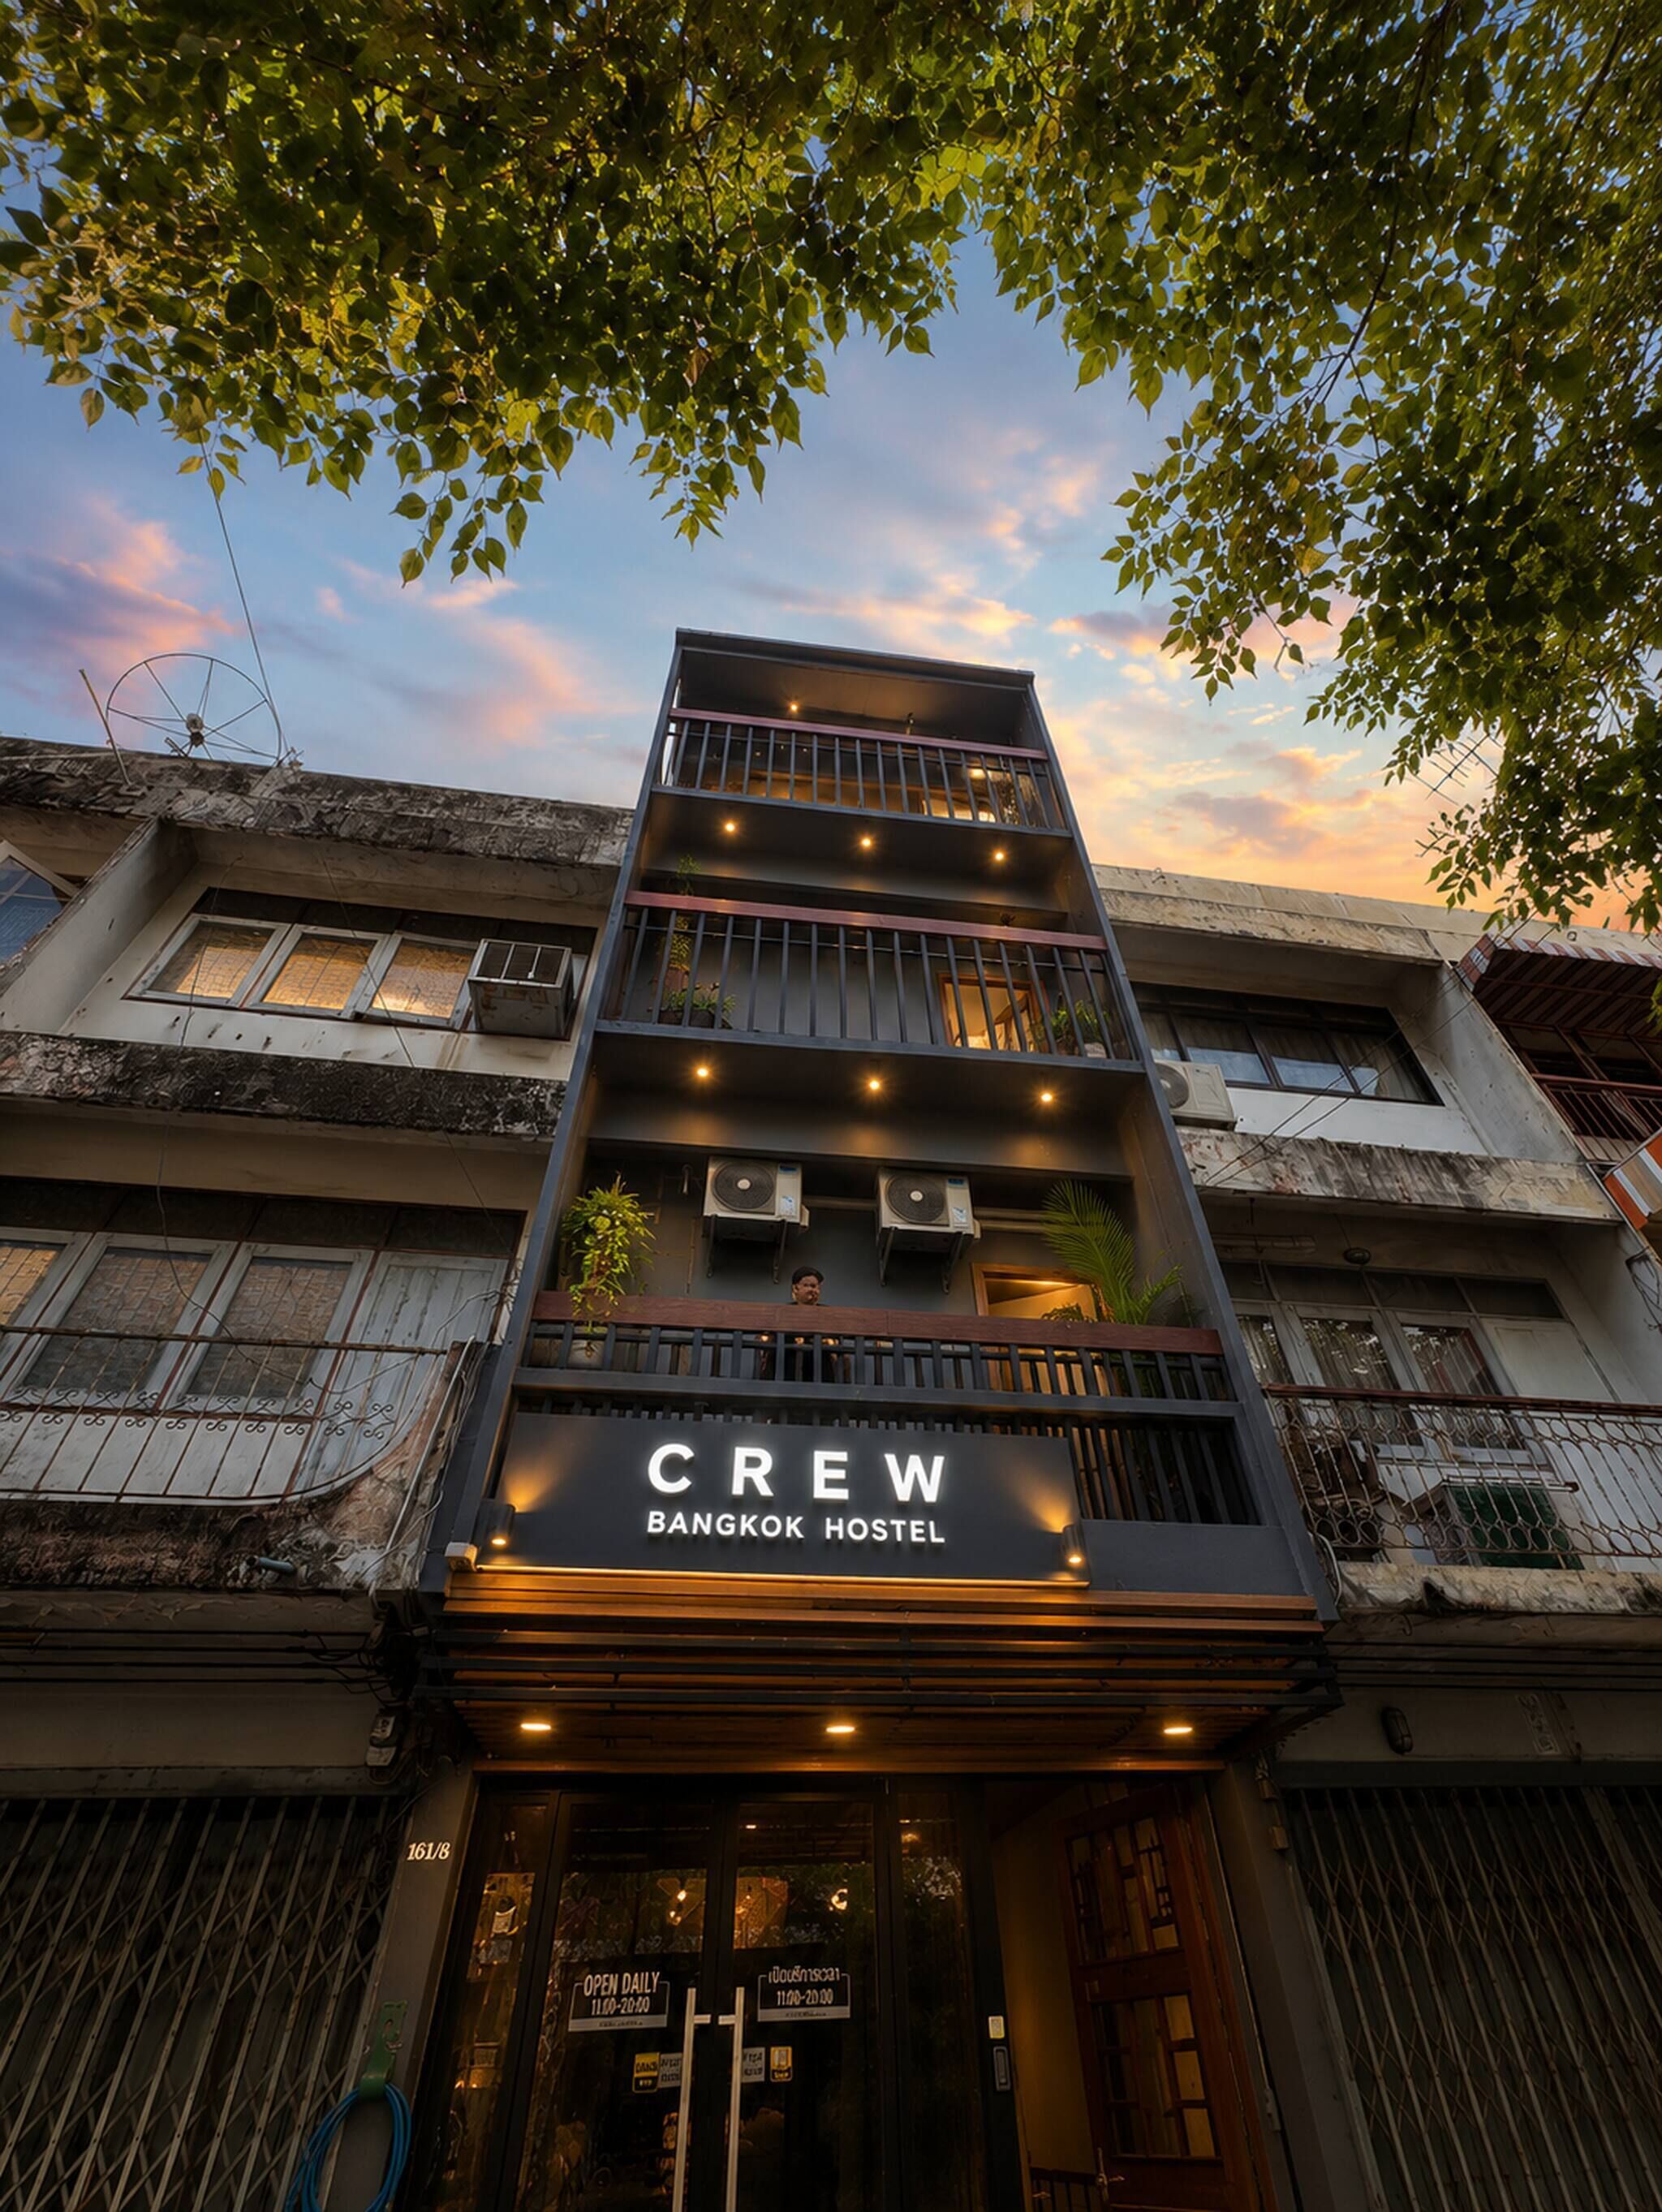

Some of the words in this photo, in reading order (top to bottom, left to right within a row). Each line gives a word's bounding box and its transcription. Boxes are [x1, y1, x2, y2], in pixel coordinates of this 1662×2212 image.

[647, 1443, 945, 1504] CREW
[646, 1509, 805, 1540] BANGKOK
[825, 1516, 946, 1545] HOSTEL
[407, 1842, 451, 1861] 161/8
[583, 1973, 619, 1997] OPEN
[621, 1970, 661, 1995] DAILY
